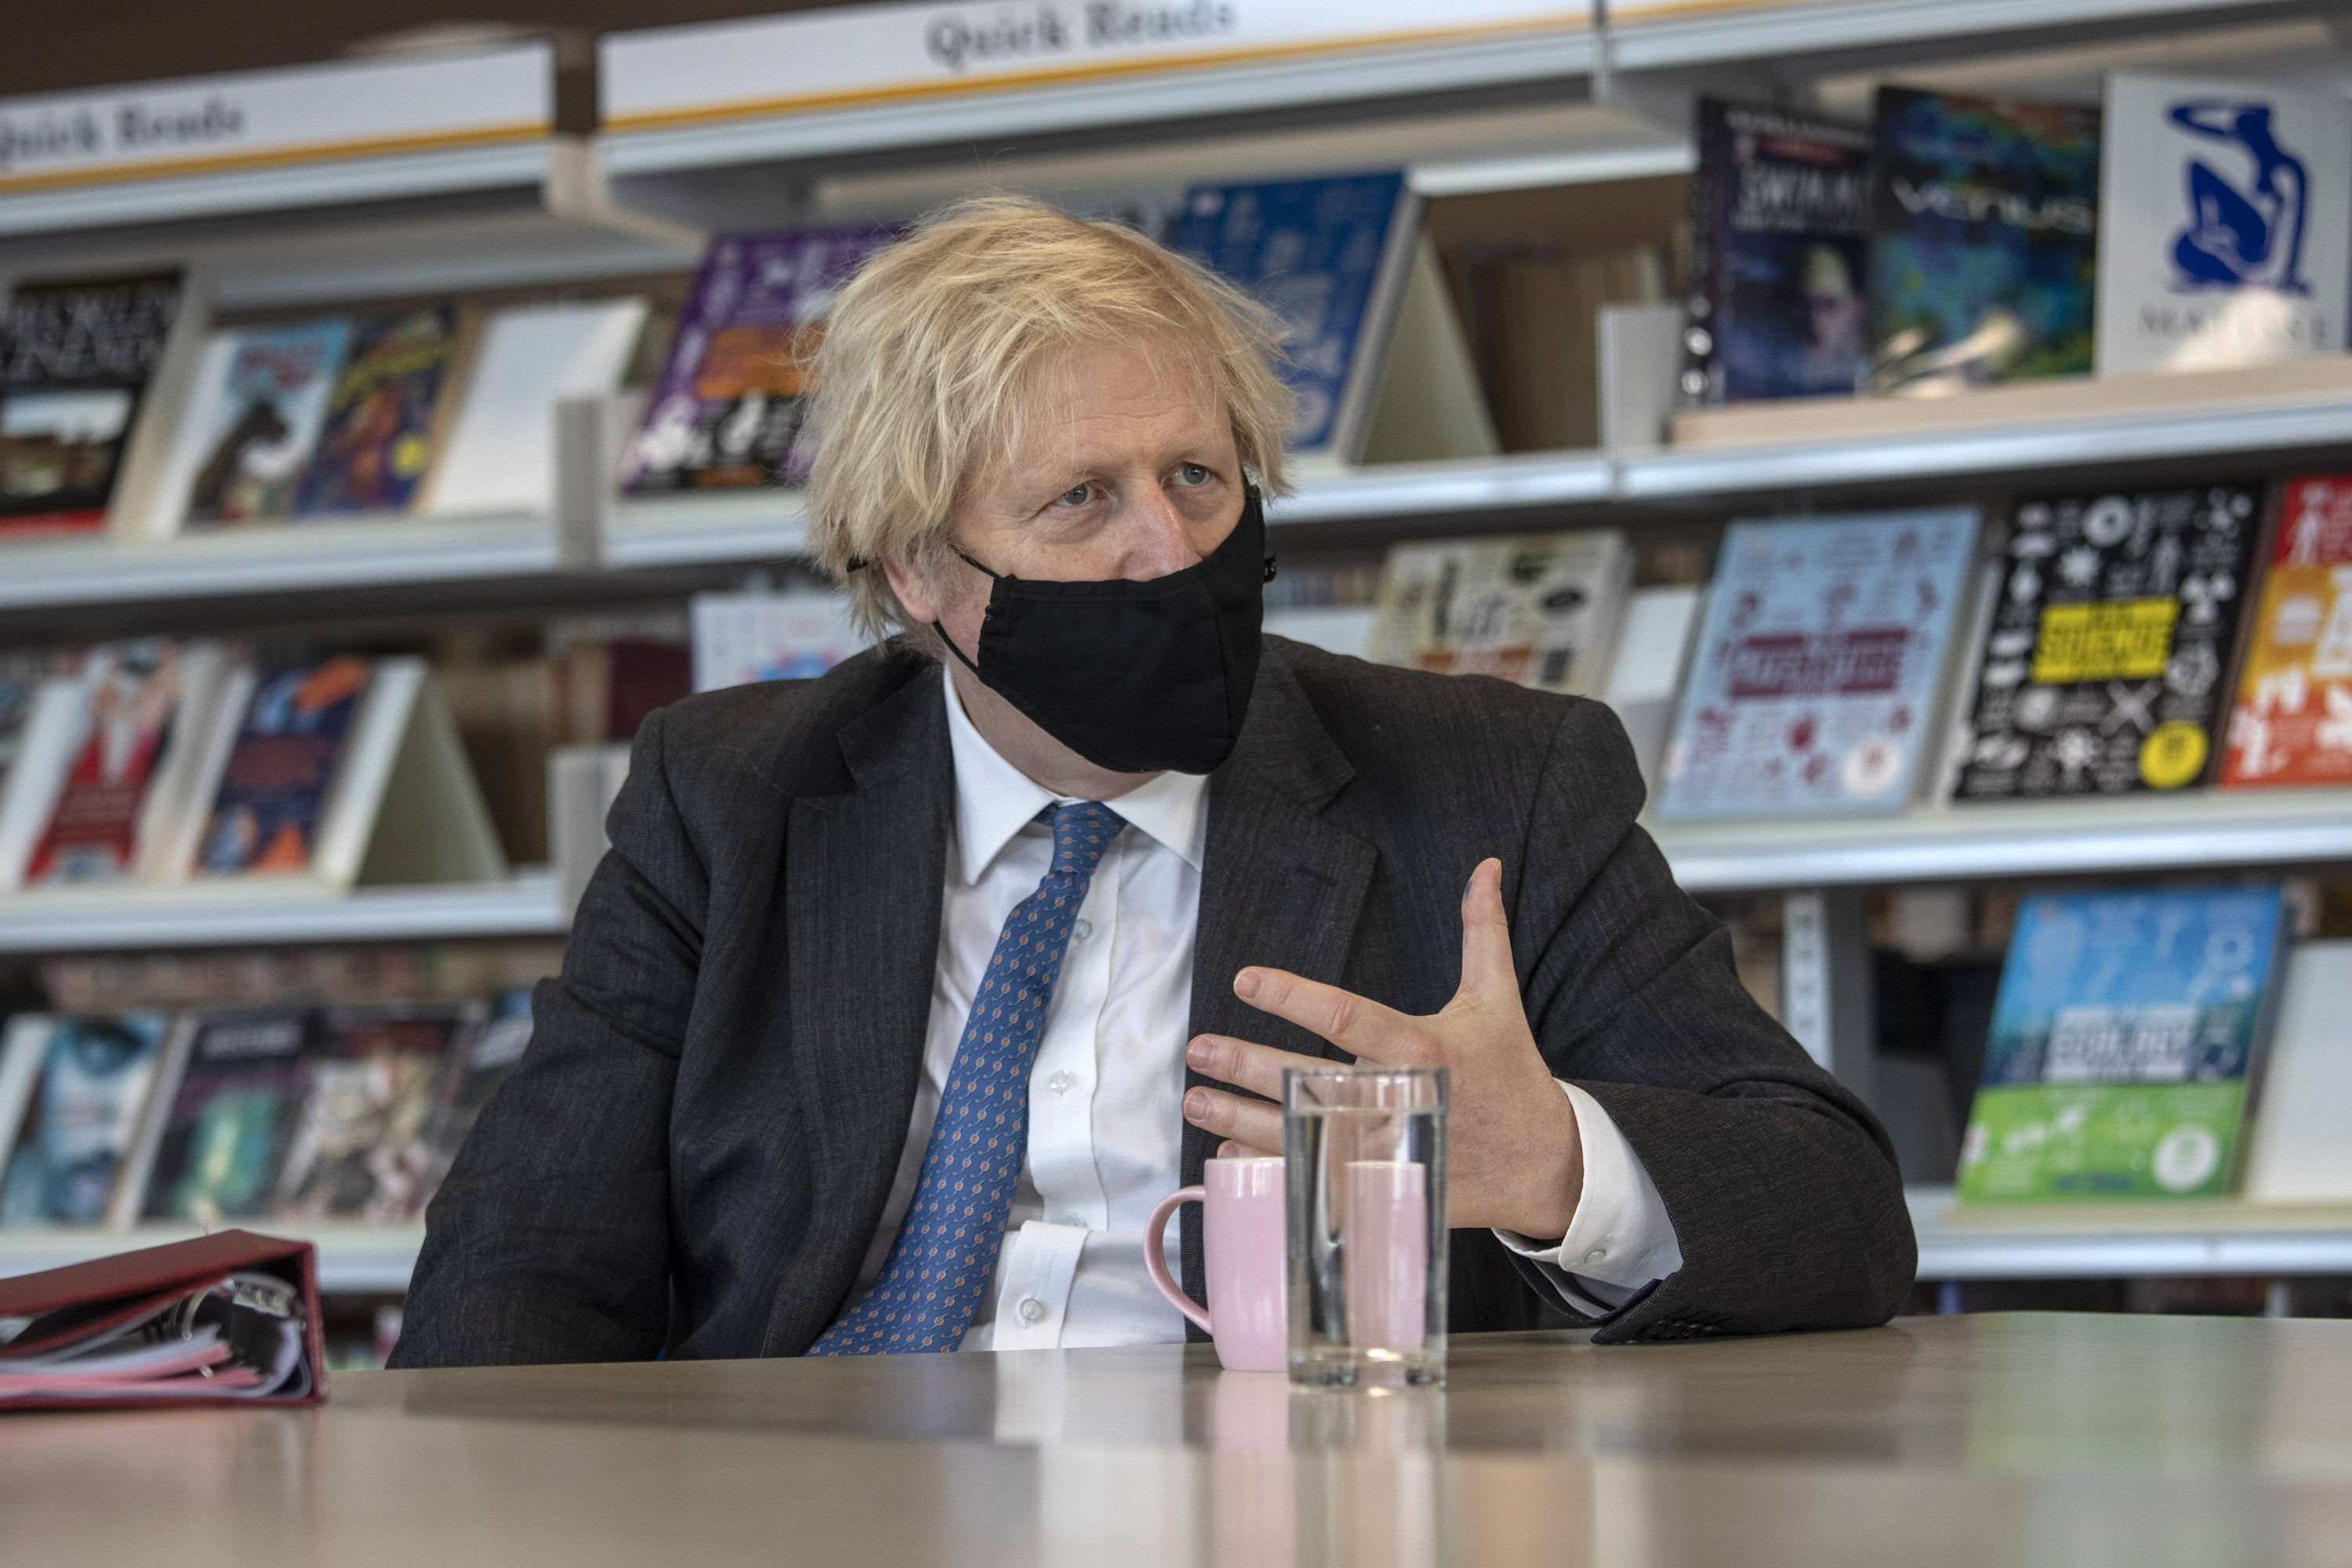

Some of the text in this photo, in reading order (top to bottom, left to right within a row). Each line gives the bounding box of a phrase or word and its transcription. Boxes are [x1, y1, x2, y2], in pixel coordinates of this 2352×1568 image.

[926, 0, 1236, 72] Quick Reads
[118, 97, 245, 147] Reads
